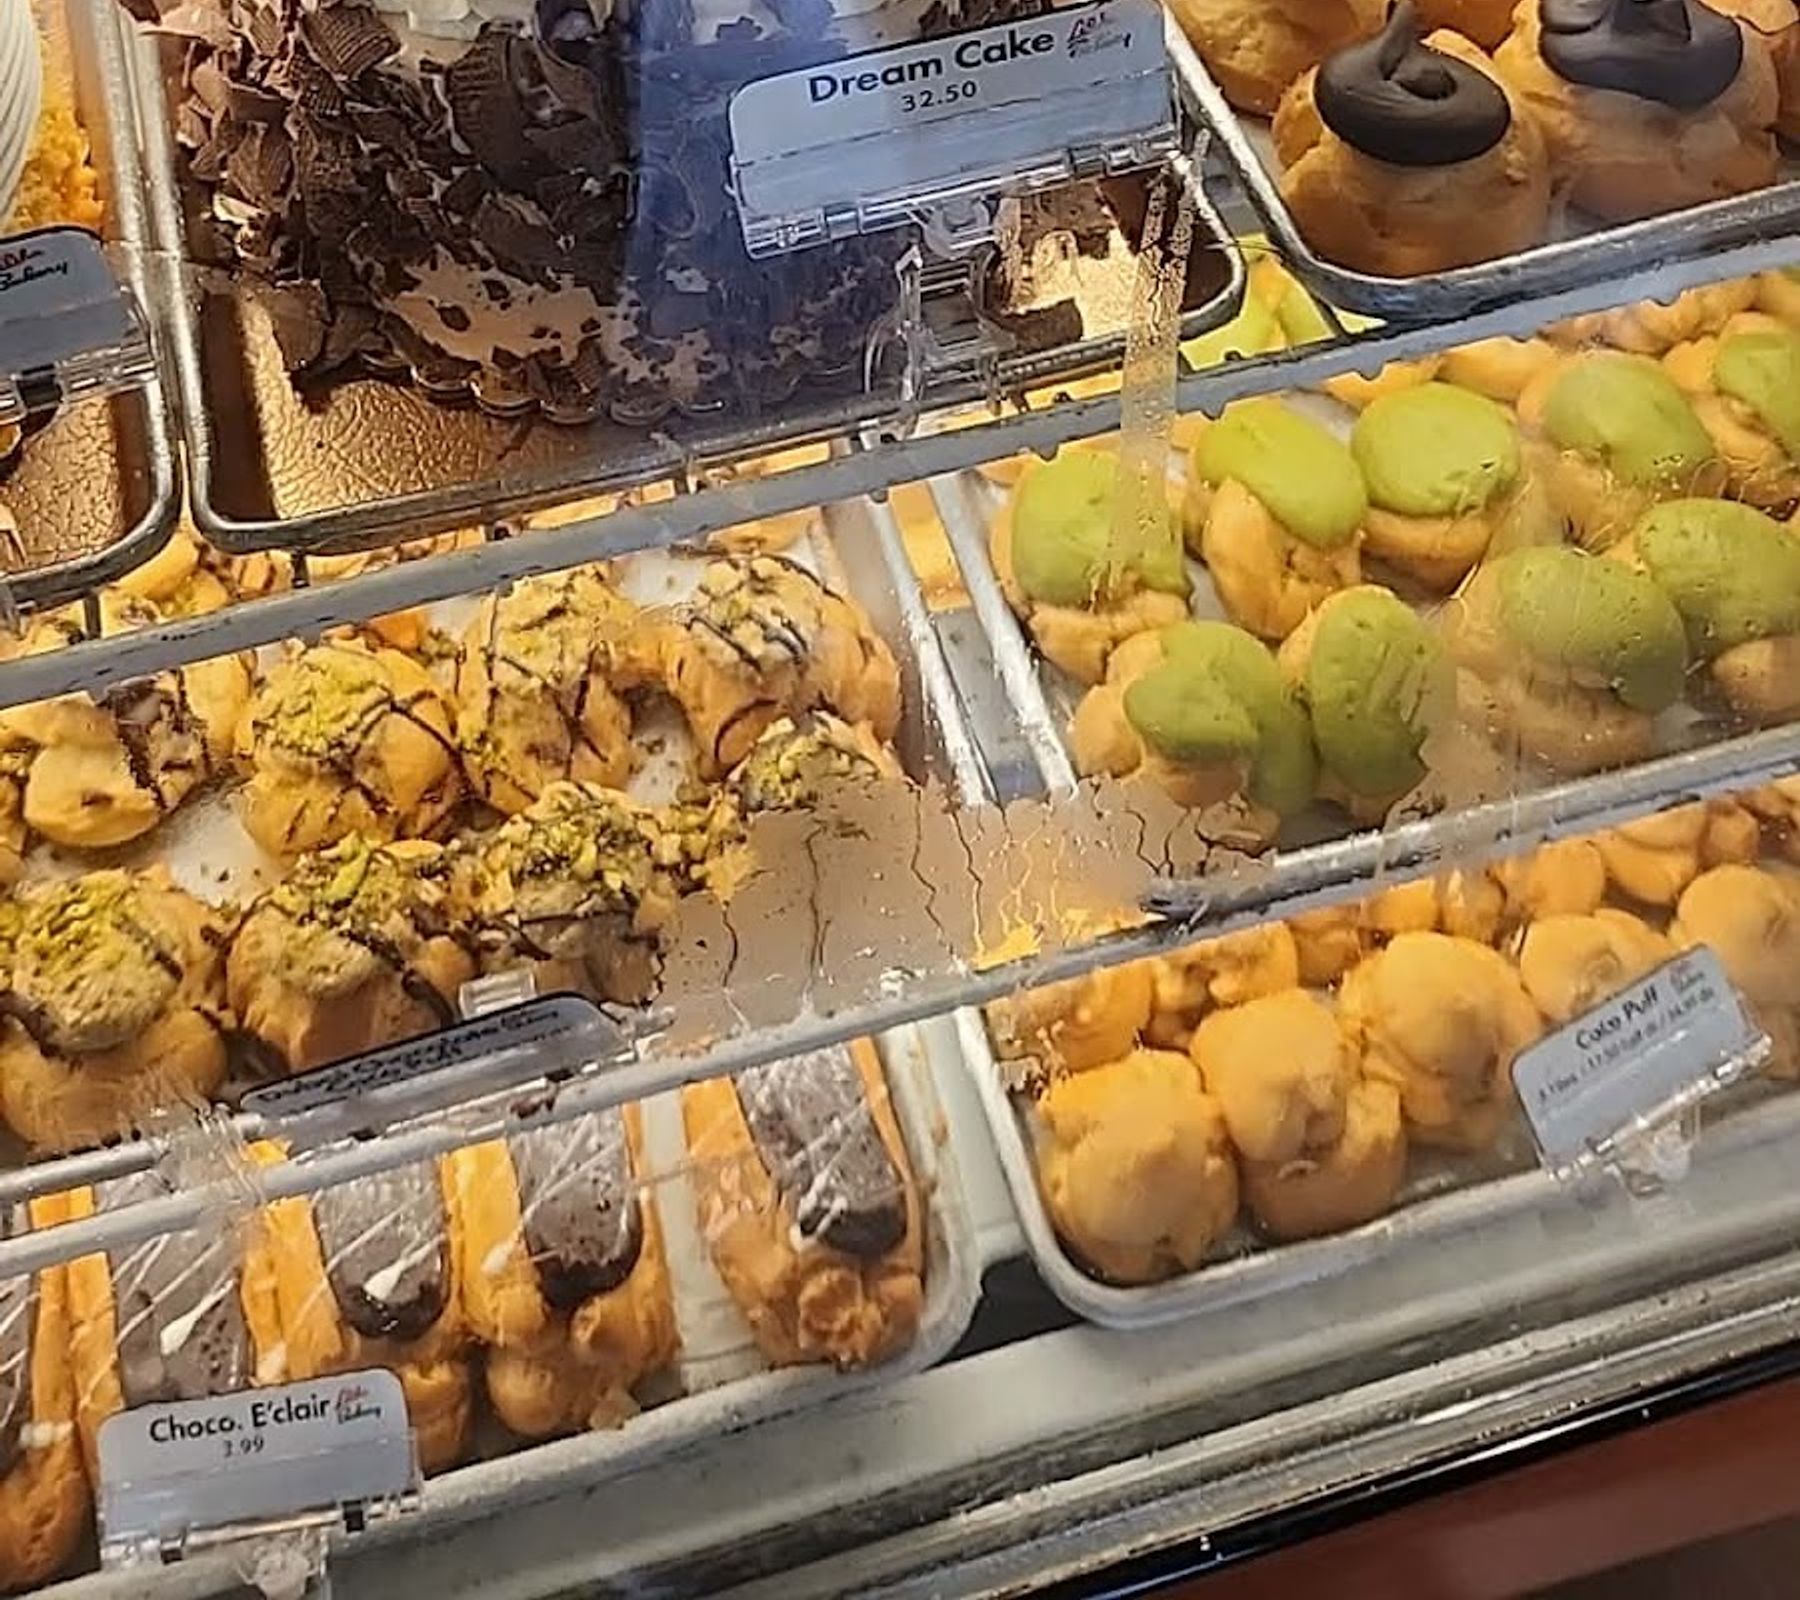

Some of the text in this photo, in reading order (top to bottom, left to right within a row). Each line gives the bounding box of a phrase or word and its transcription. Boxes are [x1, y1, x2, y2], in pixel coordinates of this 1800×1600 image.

[808, 55, 943, 103] Dream
[955, 29, 1056, 70] Cake
[902, 79, 978, 112] 32.50
[149, 1414, 244, 1443] Choco.
[252, 1393, 331, 1428] E'clair
